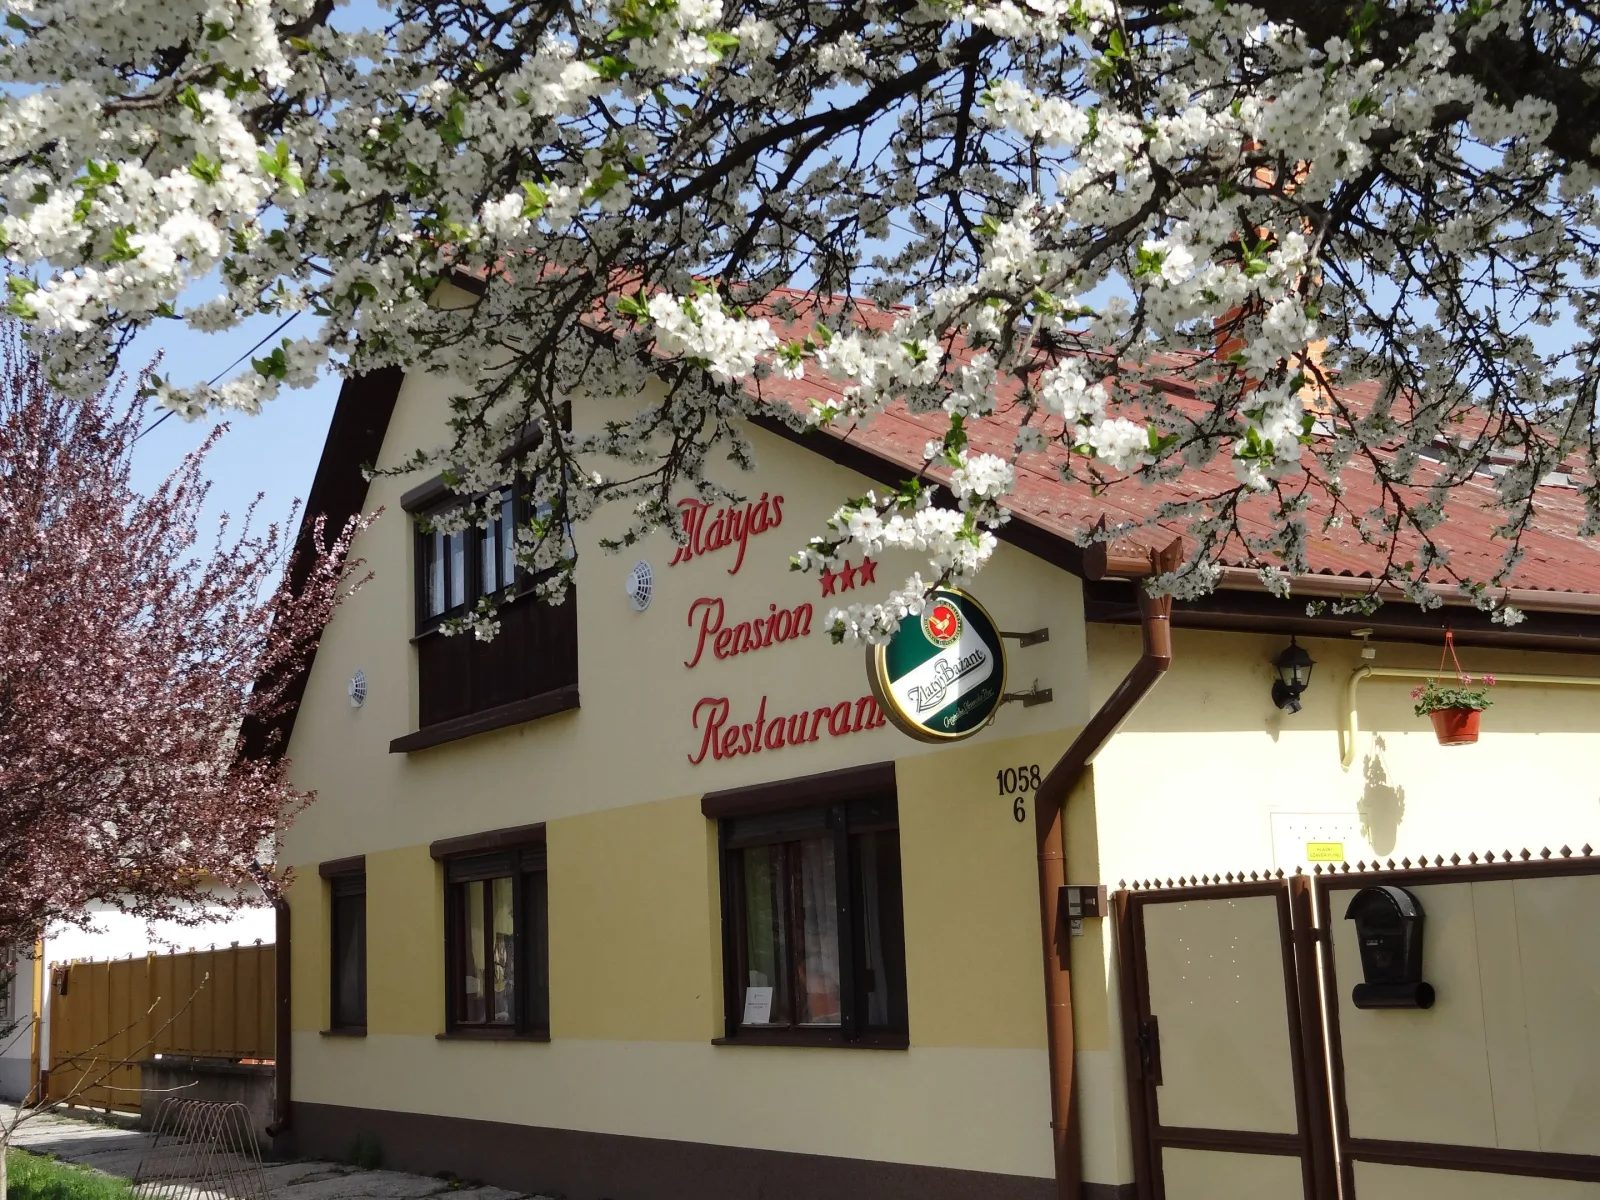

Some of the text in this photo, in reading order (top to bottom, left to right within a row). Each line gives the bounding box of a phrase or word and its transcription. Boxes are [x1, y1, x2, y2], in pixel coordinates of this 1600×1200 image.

[668, 492, 784, 575] Mátyás
[684, 597, 813, 668] Pension
[934, 648, 986, 684] Bažant
[996, 764, 1042, 796] 1058
[1013, 796, 1026, 823] 6
